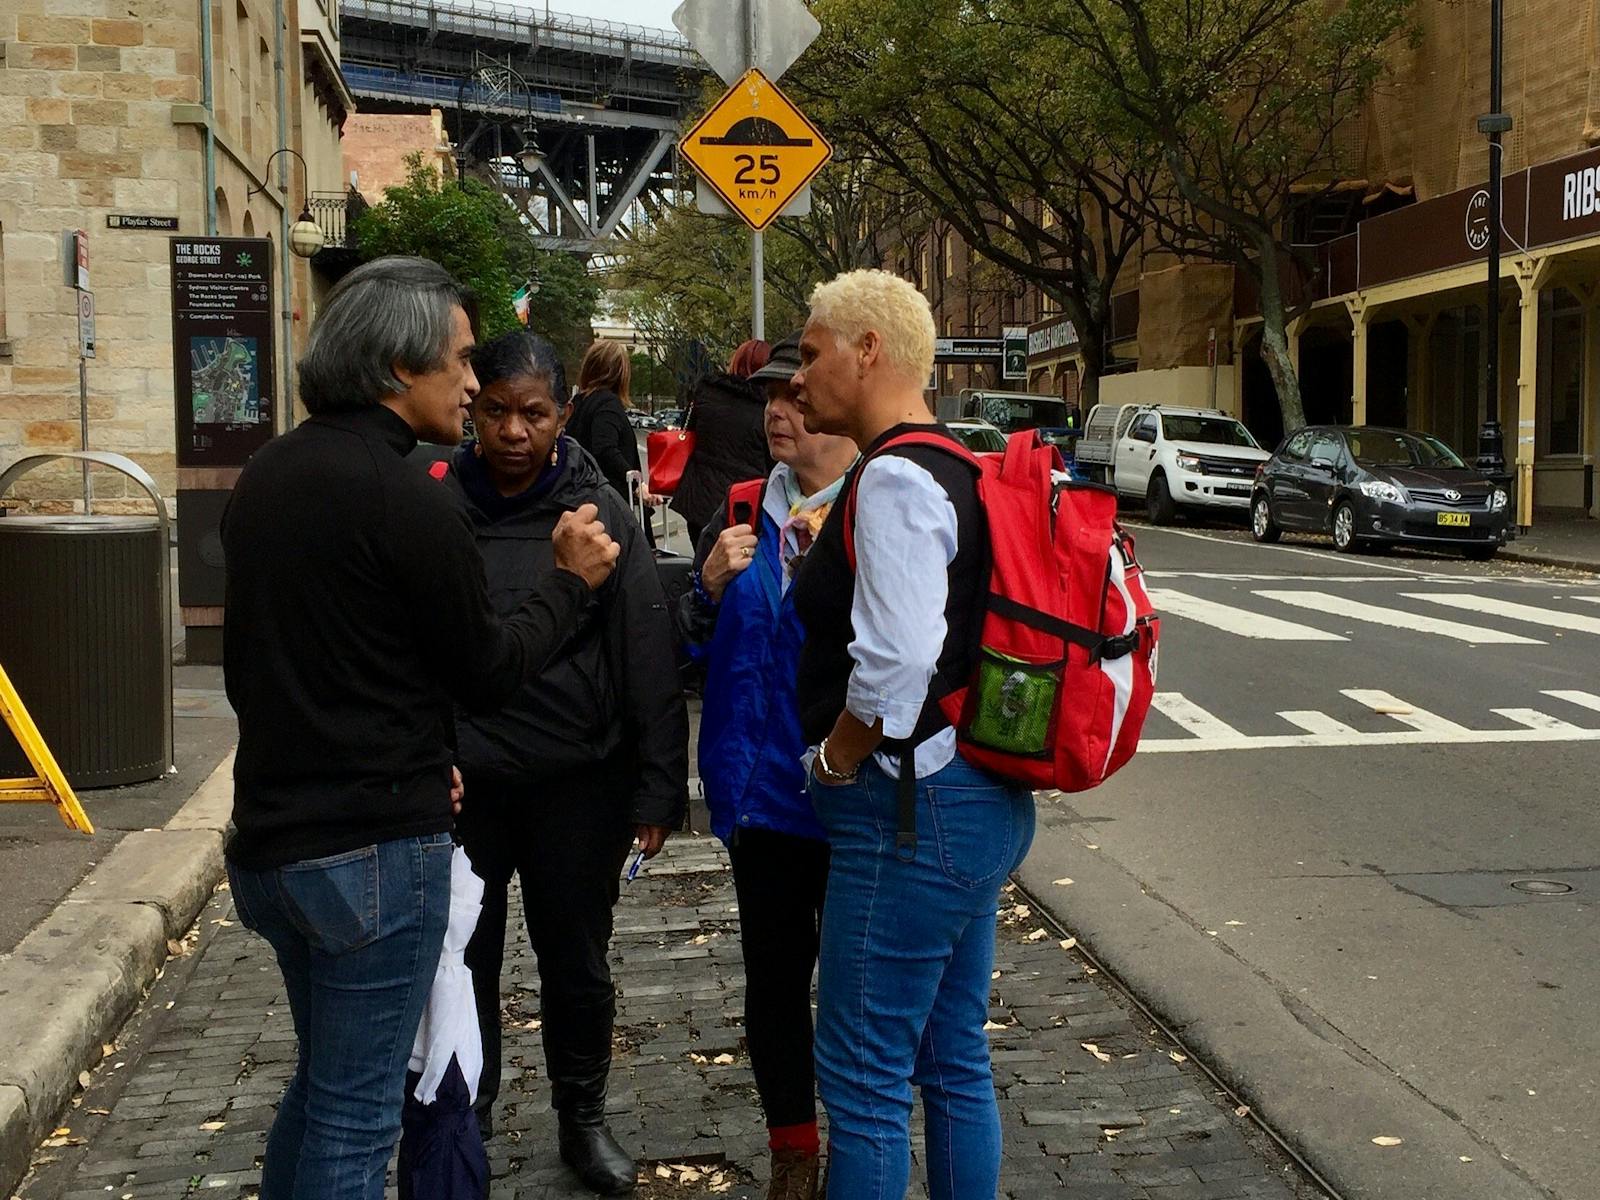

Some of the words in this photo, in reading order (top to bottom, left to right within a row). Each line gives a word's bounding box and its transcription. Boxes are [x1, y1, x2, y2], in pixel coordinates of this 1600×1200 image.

[734, 154, 780, 185] 25
[739, 188, 777, 200] km/h
[122, 217, 148, 227] Playfair
[149, 218, 171, 227] Street
[175, 243, 191, 255] THE
[193, 243, 221, 255] ROCKS
[175, 255, 199, 264] GEORGE
[199, 256, 221, 265] STREET
